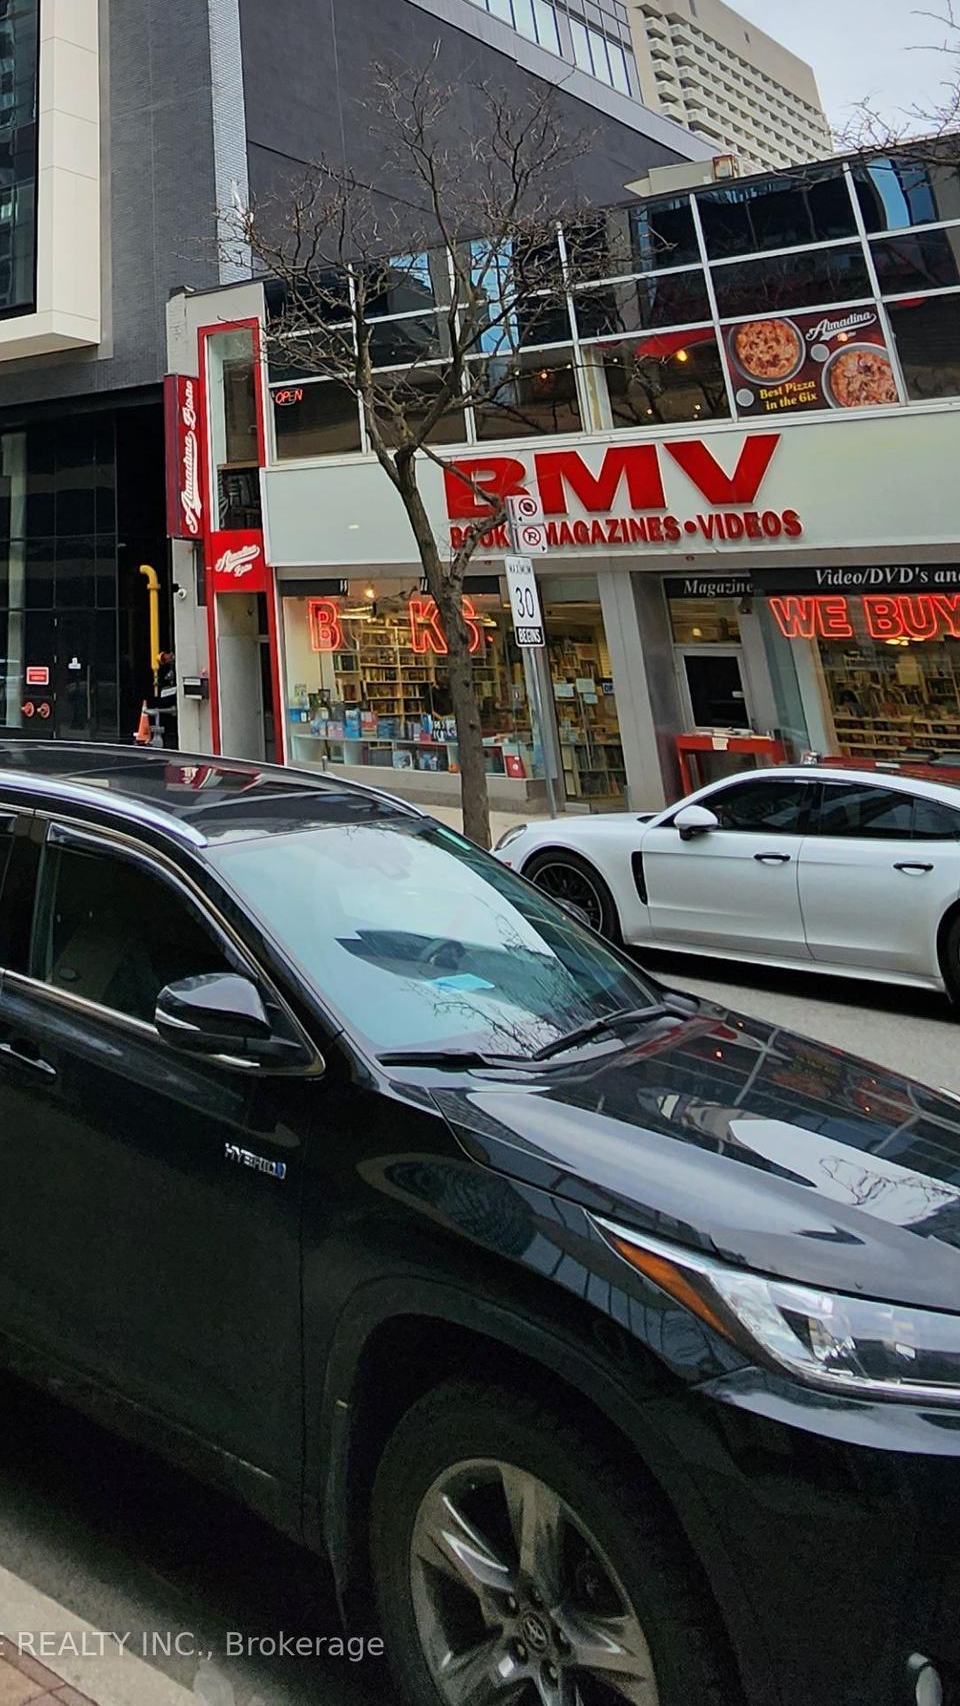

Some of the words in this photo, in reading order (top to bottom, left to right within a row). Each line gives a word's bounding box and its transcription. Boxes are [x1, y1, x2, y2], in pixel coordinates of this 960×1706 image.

[805, 311, 877, 341] Almadina
[275, 389, 303, 404] OPEN
[759, 386, 783, 400] Best
[785, 380, 816, 394] Pizza
[765, 400, 778, 411] in
[779, 396, 798, 408] the
[181, 430, 201, 534] Almadina
[443, 432, 782, 520] BMV
[815, 566, 929, 585] Video/DVD's
[934, 569, 960, 583] an
[515, 587, 535, 619] 30
[769, 596, 853, 638] WE
[862, 595, 960, 639] BUY
[518, 628, 541, 643] BEGINS
